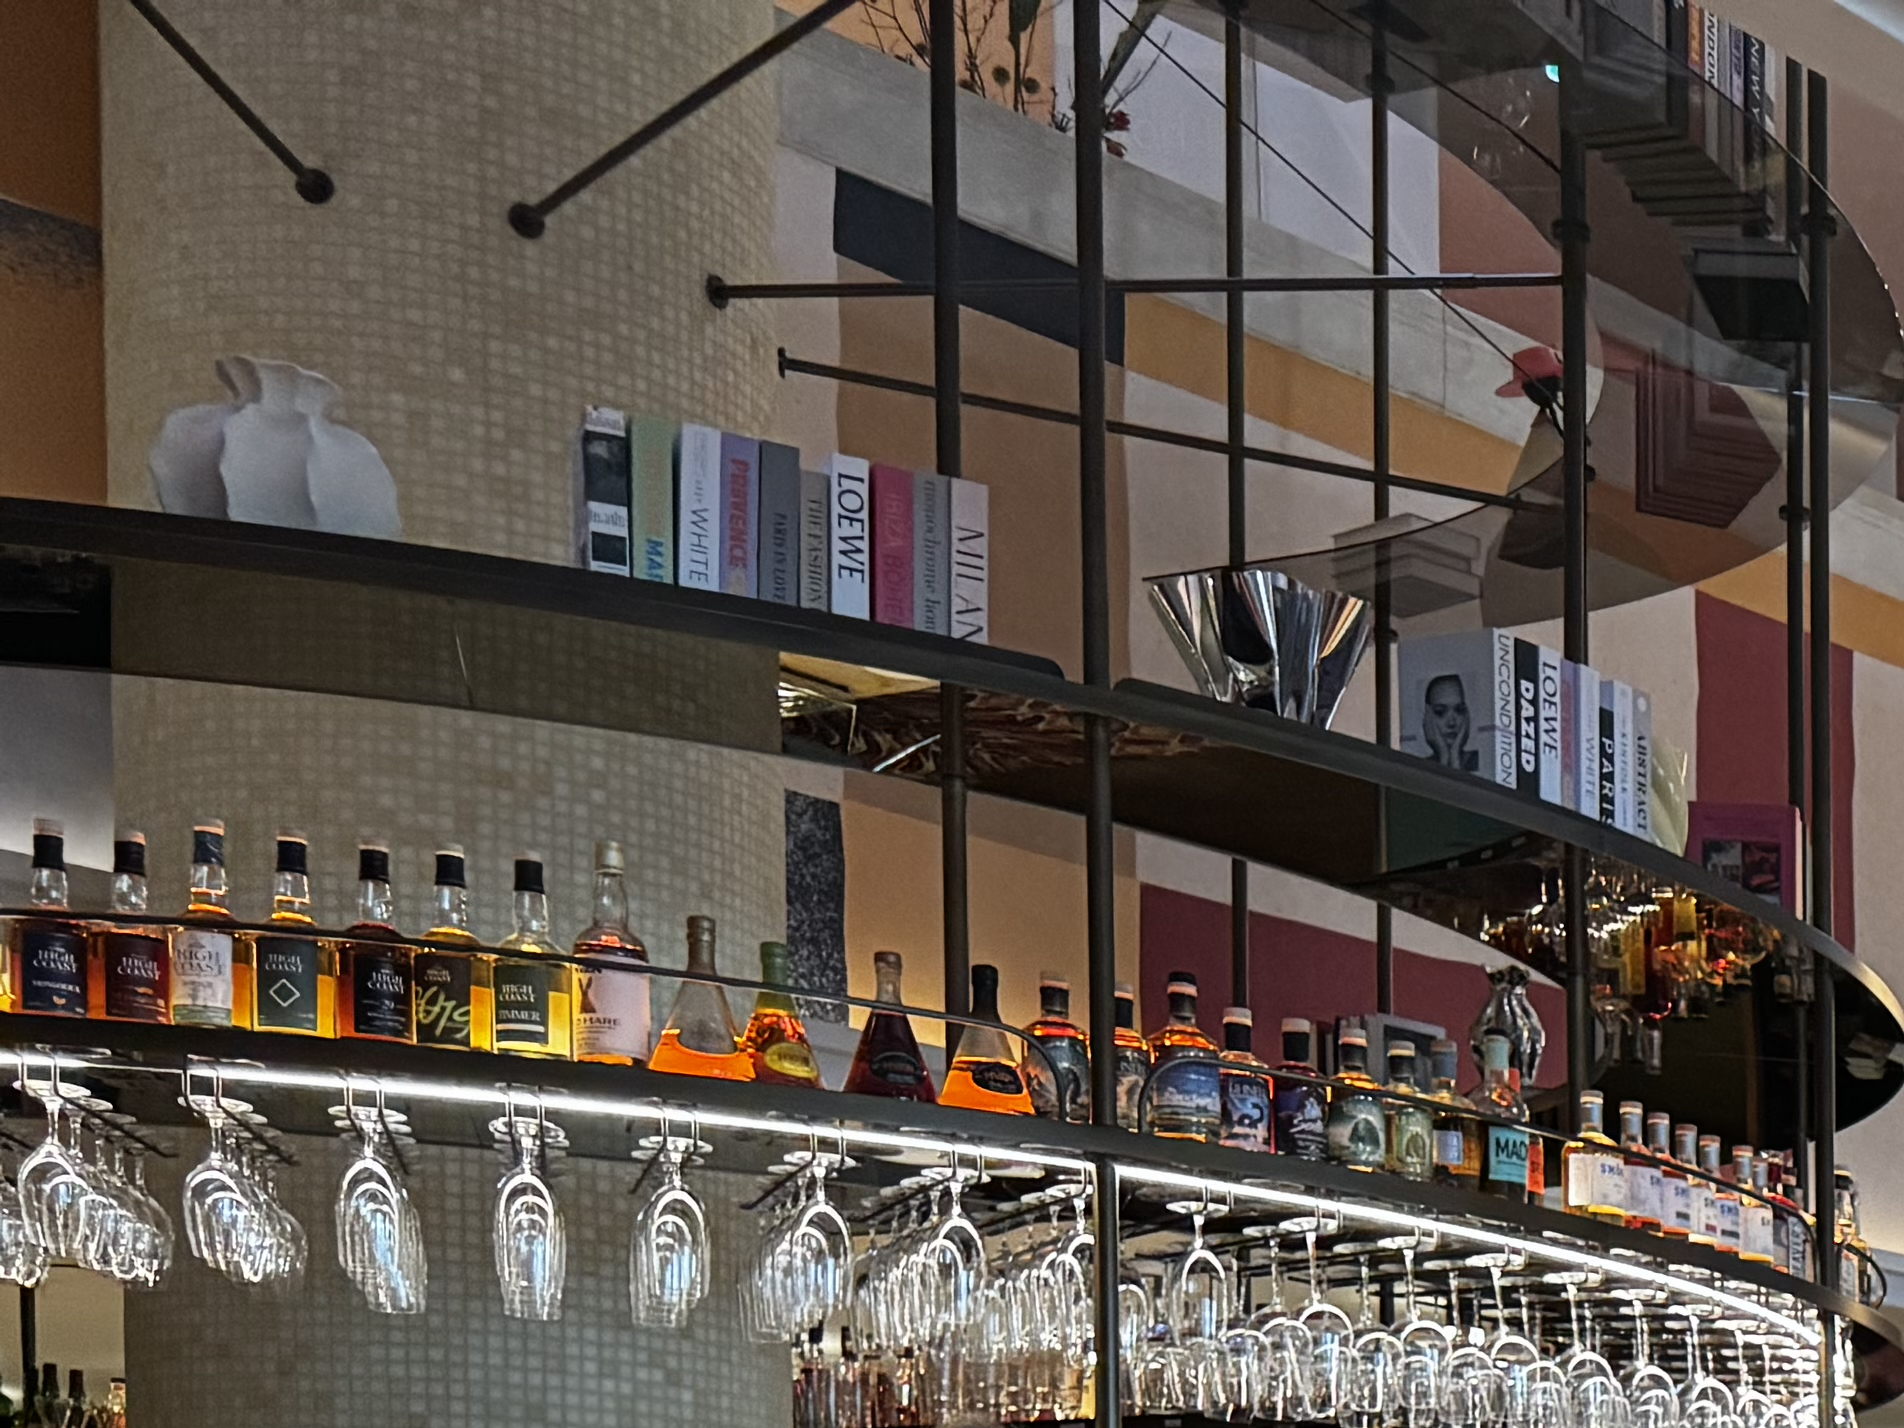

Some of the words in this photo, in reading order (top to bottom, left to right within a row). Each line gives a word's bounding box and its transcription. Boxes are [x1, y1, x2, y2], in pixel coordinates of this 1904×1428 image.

[689, 508, 709, 584] WHITE
[837, 472, 865, 584] LOEWE
[922, 479, 941, 593] monochrome
[806, 533, 823, 604] FASHION
[954, 525, 985, 640] MILAN
[1519, 679, 1536, 773] DAZED
[1541, 661, 1558, 760] LOEWE
[1584, 736, 1596, 797] WHITE
[1601, 736, 1614, 826] PARIS
[1636, 734, 1648, 833] ABSTRACT
[32, 959, 79, 973] COAST
[38, 949, 74, 963] HIGH
[117, 966, 161, 981] COAST
[122, 956, 158, 970] HIGH
[264, 961, 303, 973] COAST
[269, 953, 302, 964] HIGH
[367, 980, 405, 994] COAST
[372, 971, 403, 983] HIGH
[502, 984, 532, 995] HIGH
[499, 992, 536, 1003] COAST
